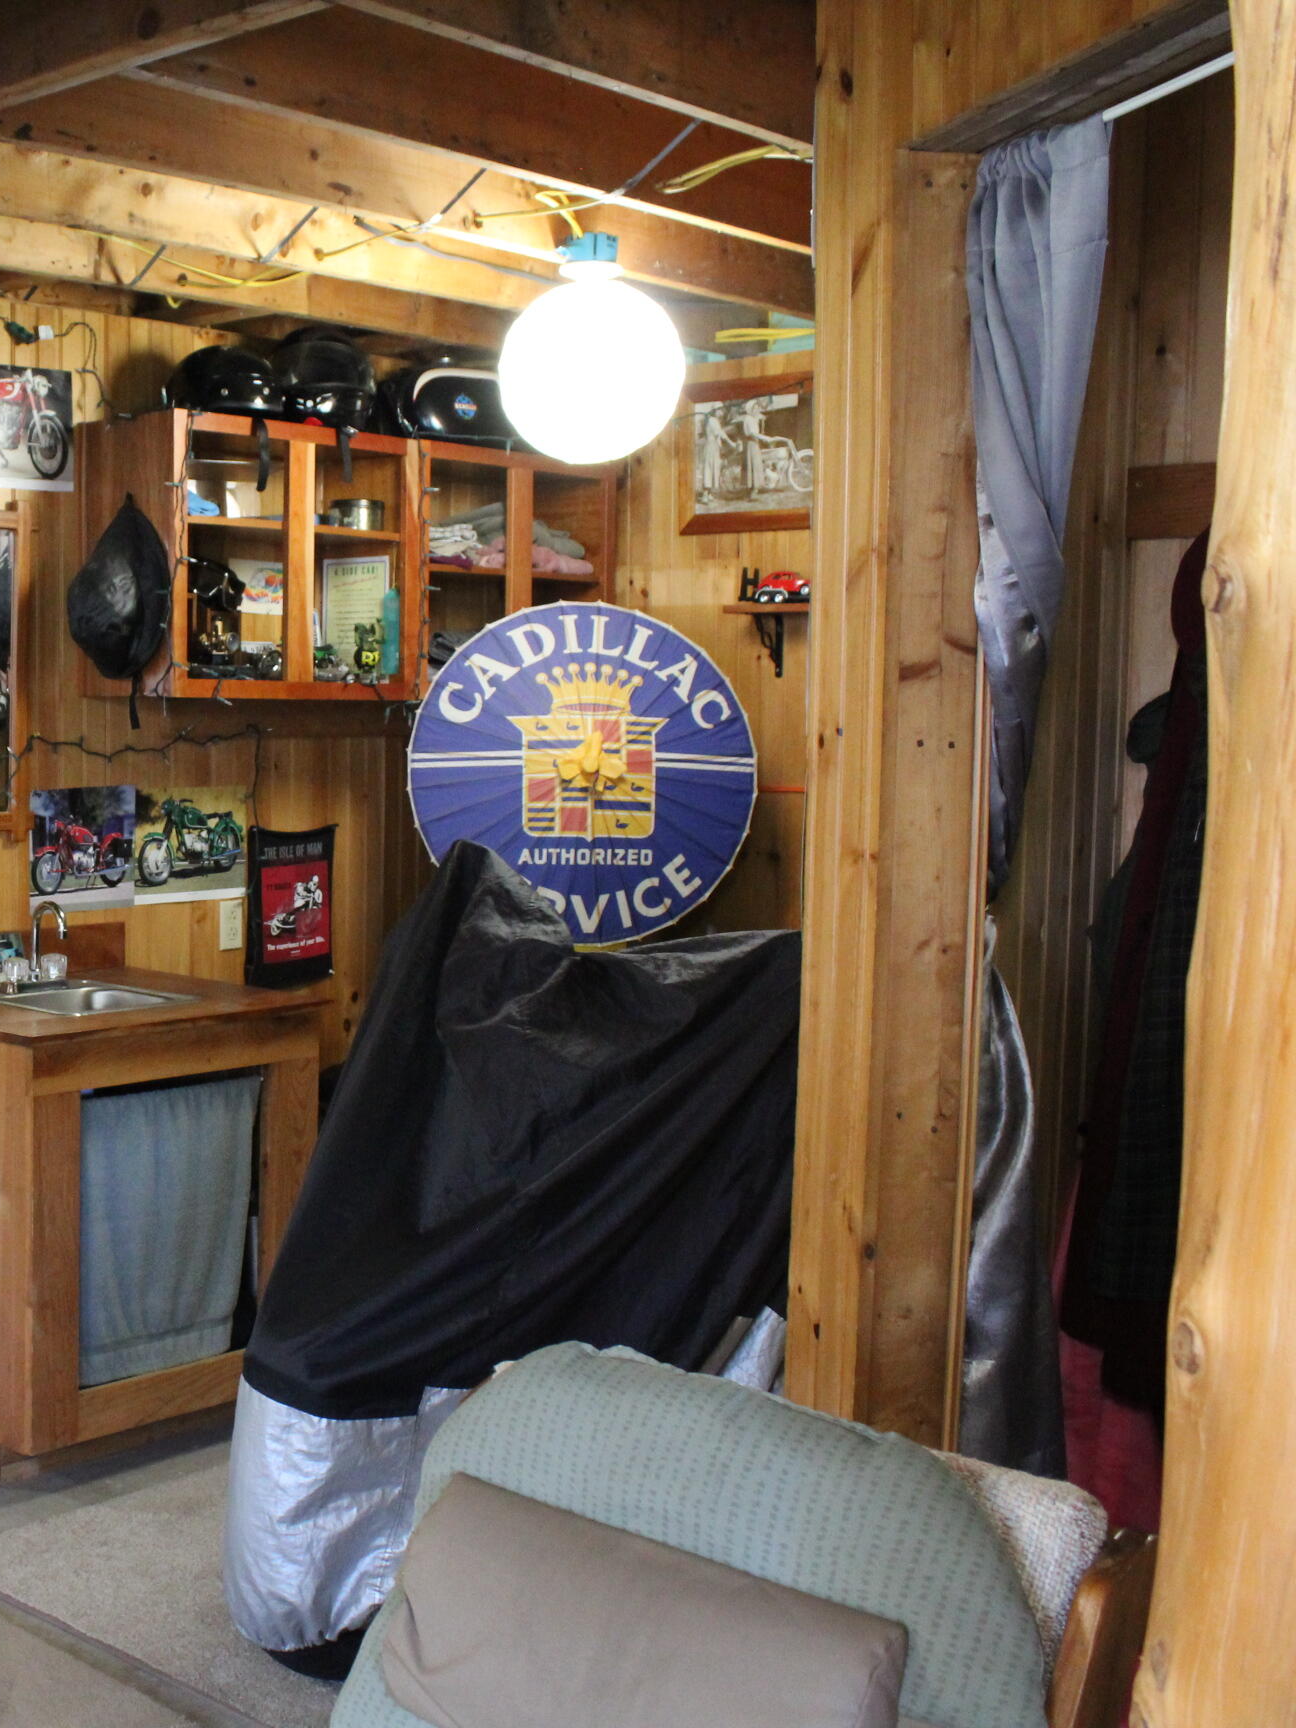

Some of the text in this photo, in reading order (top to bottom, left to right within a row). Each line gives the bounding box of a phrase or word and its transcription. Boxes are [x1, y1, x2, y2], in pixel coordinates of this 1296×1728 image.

[438, 614, 732, 730] CADILLAC
[264, 843, 323, 859] THE ISLE OF MAN
[518, 848, 653, 866] AUTHORIZED
[521, 853, 702, 934] VICE
